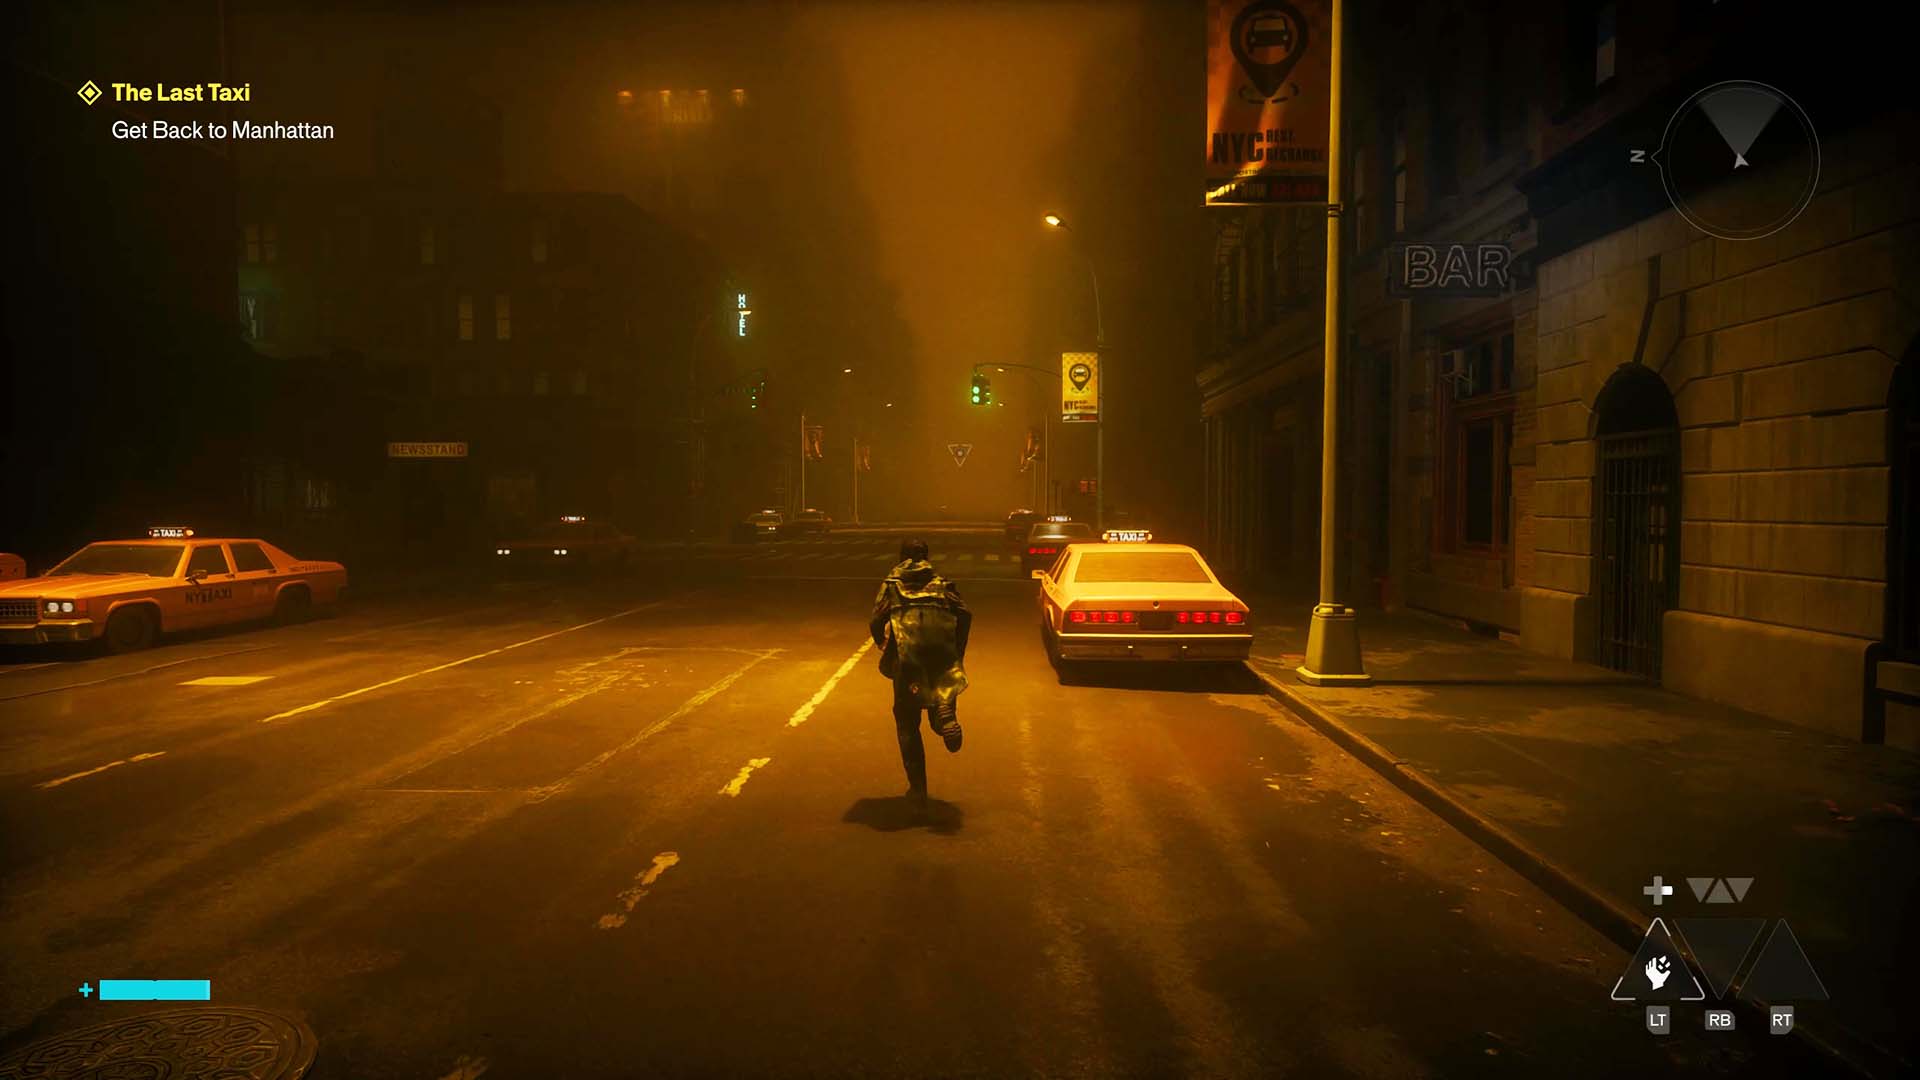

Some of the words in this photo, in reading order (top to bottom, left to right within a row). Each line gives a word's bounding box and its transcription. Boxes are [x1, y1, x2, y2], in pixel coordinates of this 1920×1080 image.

[1213, 131, 1264, 162] NYC
[1403, 244, 1512, 289] BAR
[738, 293, 750, 337] HOTEL
[392, 444, 465, 456] NEWSSTAND
[160, 529, 176, 537] TAXI
[1118, 532, 1137, 542] TAXI
